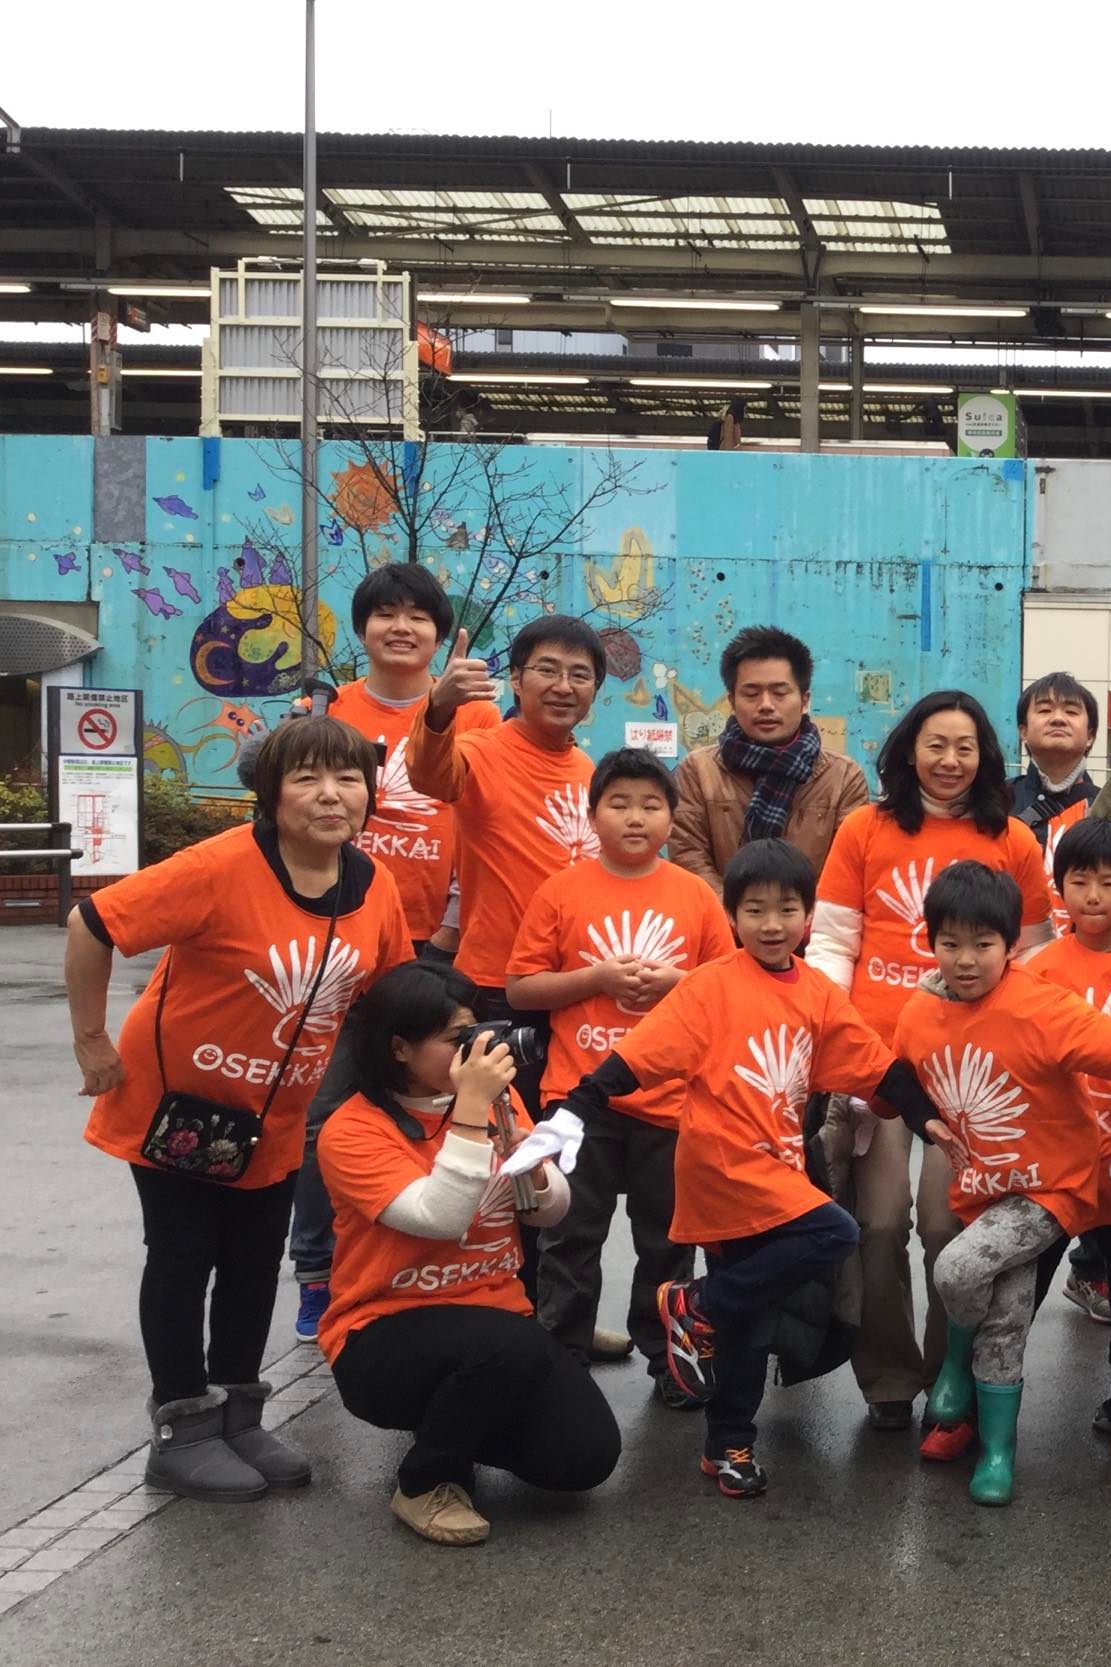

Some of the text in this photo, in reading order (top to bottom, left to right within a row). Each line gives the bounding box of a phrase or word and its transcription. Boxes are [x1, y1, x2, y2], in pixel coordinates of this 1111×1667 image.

[351, 831, 441, 860] EKKAI
[576, 1024, 632, 1052] OSE
[957, 1162, 1042, 1195] EKKAI
